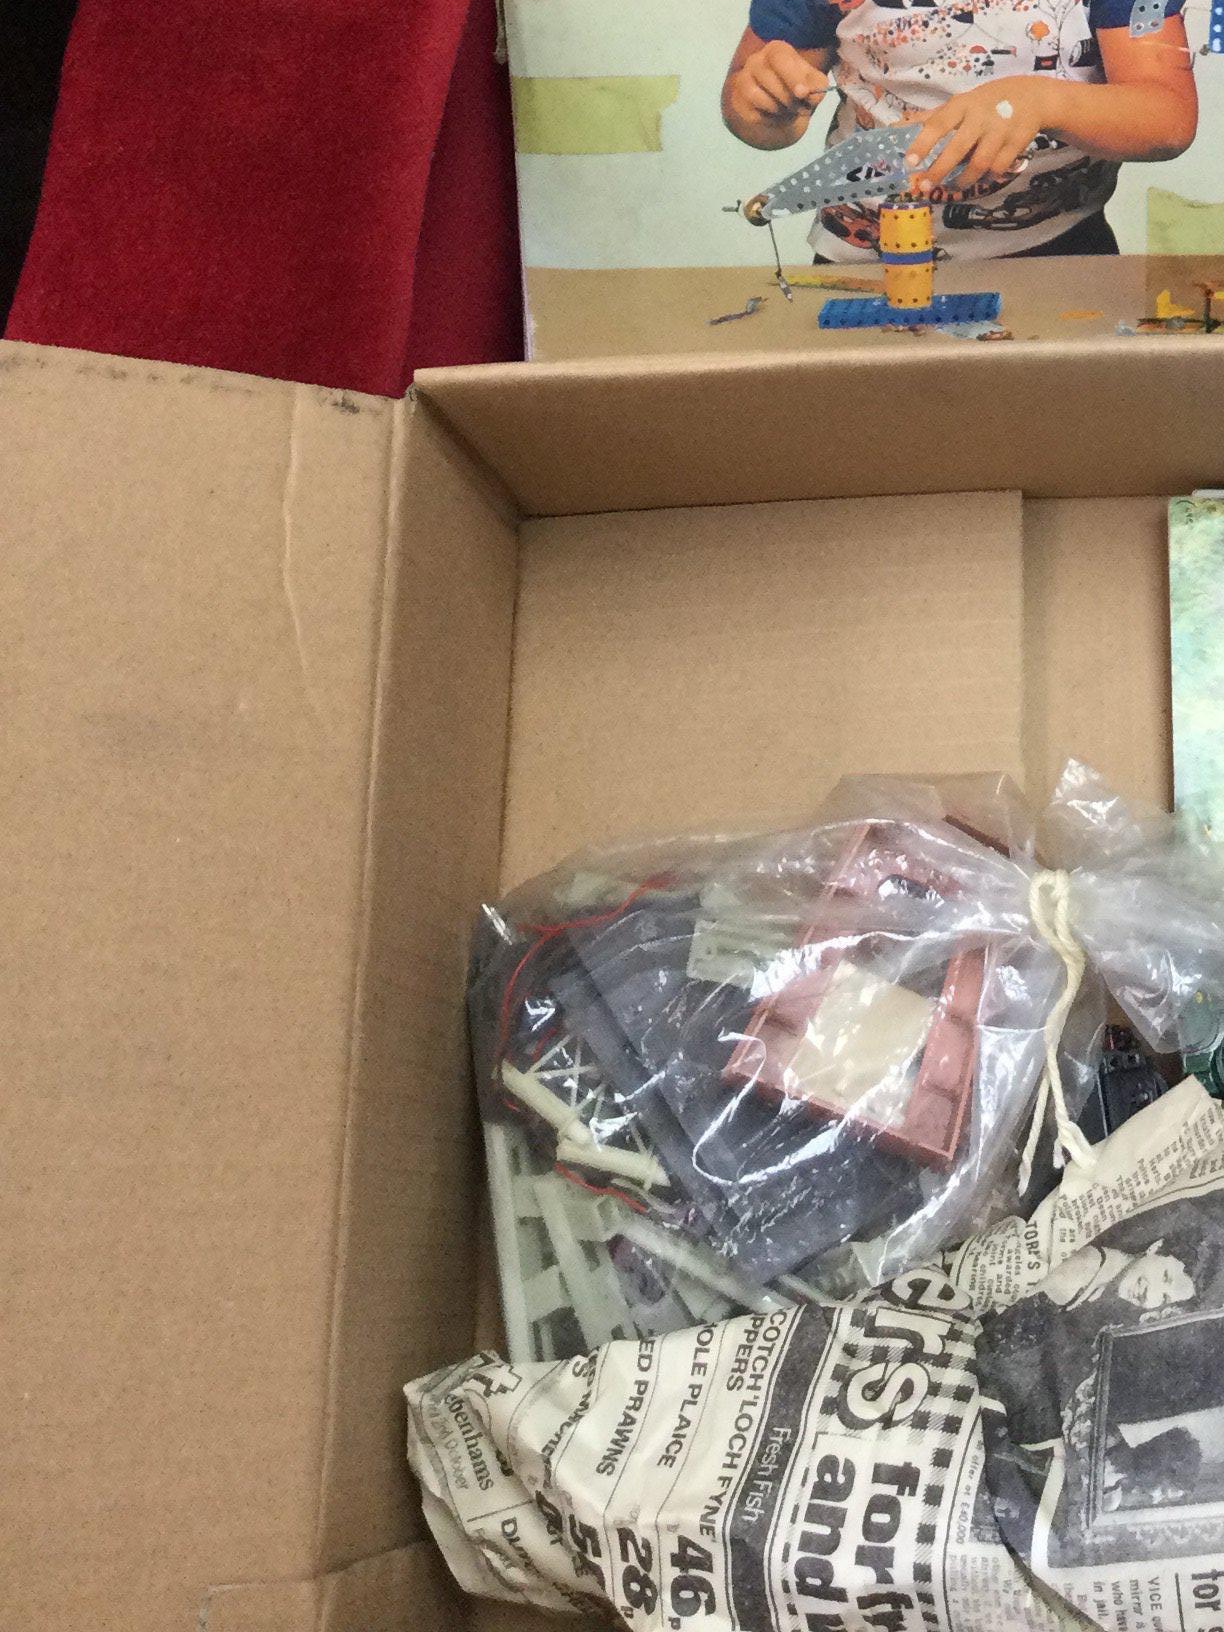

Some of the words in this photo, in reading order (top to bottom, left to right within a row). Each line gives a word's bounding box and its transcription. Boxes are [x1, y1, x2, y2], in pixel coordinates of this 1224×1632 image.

[748, 1308, 787, 1390] COTCH
[596, 1380, 650, 1477] PRAWNS
[657, 1383, 703, 1469] PLAICE
[757, 1425, 792, 1473] Fresh
[741, 1474, 776, 1523] Fish
[795, 1454, 856, 1602] and
[855, 1461, 920, 1585] for
[1148, 1576, 1163, 1611] VICE
